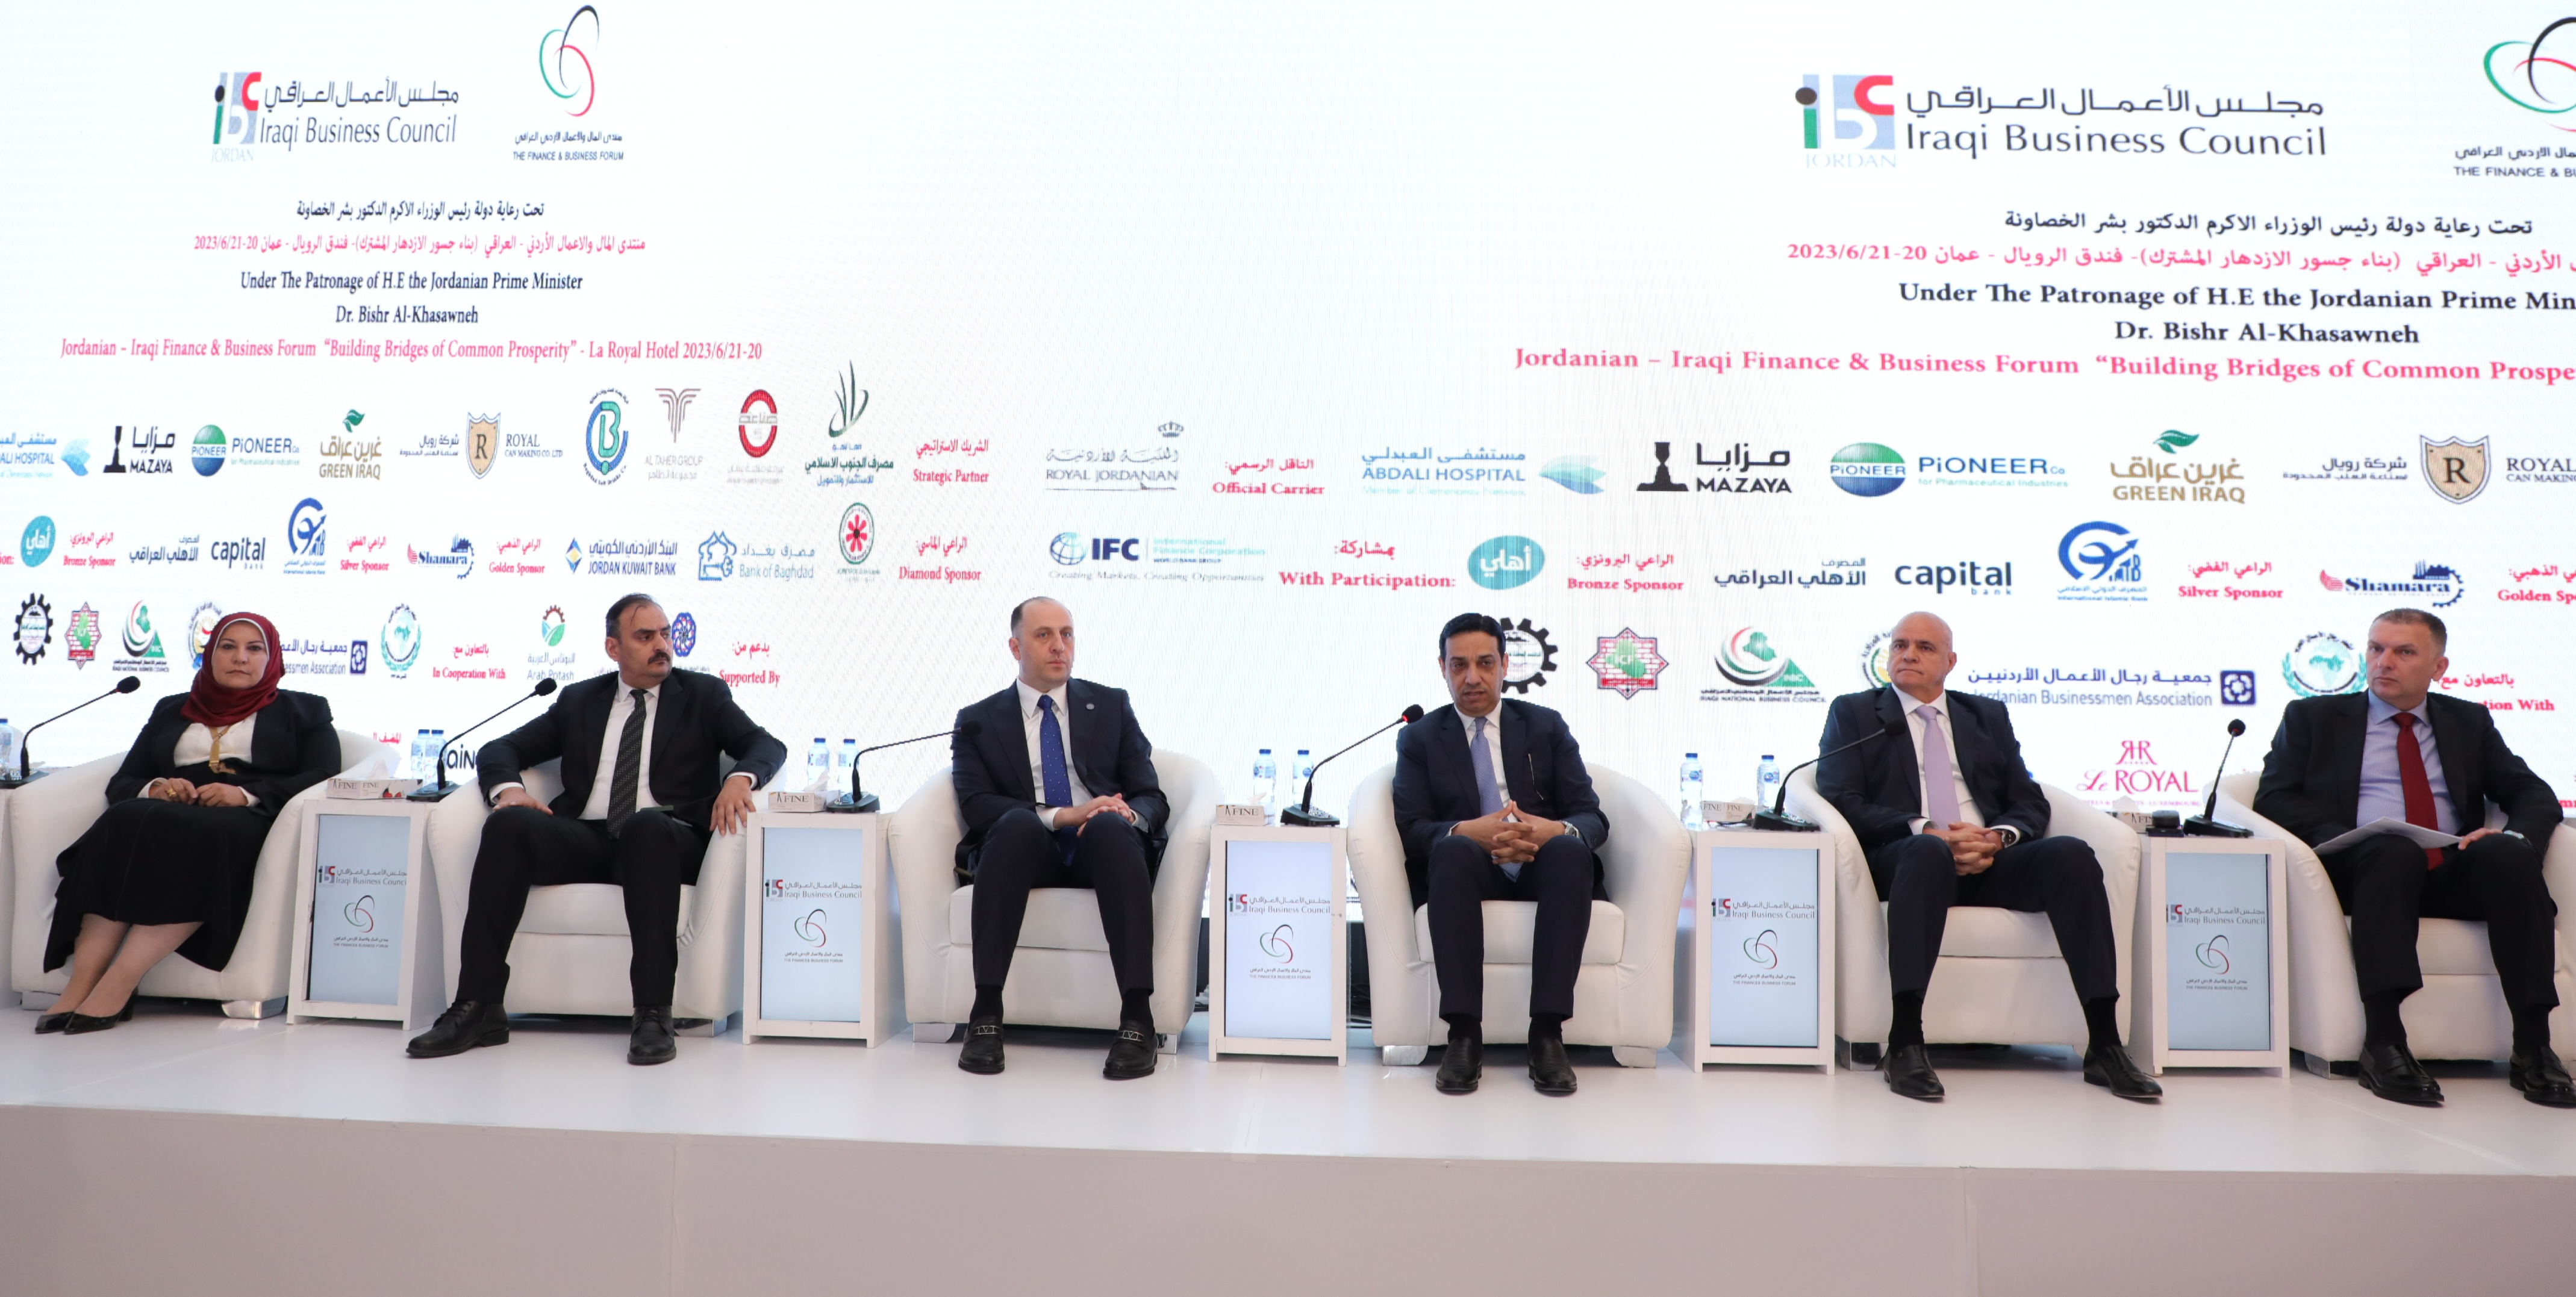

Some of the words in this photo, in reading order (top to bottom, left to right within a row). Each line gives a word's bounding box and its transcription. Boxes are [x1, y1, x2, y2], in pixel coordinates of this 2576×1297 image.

[1907, 86, 2055, 118] العراقي
[2062, 85, 2189, 116] الأعمال
[2196, 92, 2324, 118] مجلس
[260, 117, 299, 151] Iraqi
[306, 117, 379, 143] Business
[387, 114, 457, 142] Council
[1907, 123, 1987, 159] Iraqi
[2006, 125, 2165, 153] Business
[2180, 126, 2325, 155] Council
[513, 151, 525, 160] THE
[528, 151, 555, 160] FINANCE
[558, 152, 562, 160] &
[565, 151, 597, 160] BUSINESS
[600, 151, 623, 160] FORUM
[2454, 167, 2480, 176] THE
[2486, 167, 2544, 176] FINANCE
[2551, 168, 2559, 177] &
[2006, 211, 2085, 231] الخصاونة
[2094, 214, 2126, 233] بشر
[2136, 213, 2198, 234] الدكتور
[2207, 214, 2256, 237] الاكرم
[2265, 216, 2321, 236] الوزراء
[2331, 217, 2377, 237] رئيس
[2386, 216, 2425, 237] دولة
[2434, 217, 2480, 238] رعاية
[2489, 220, 2532, 234] تحت
[1789, 244, 1927, 260] 2023/6/21-20
[242, 271, 276, 288] Under
[281, 271, 301, 288] The
[305, 272, 363, 294] Patronage
[367, 271, 380, 288] of
[382, 272, 405, 288] H.E
[409, 271, 427, 288] the
[431, 272, 488, 291] Jordanian
[493, 272, 528, 289] Prime
[532, 272, 583, 289] Minister
[1899, 283, 1977, 301] Under
[1986, 284, 2031, 302] The
[2041, 285, 2164, 309] Patronage
[2174, 287, 2200, 304] of
[2207, 288, 2254, 305] H.E
[2263, 288, 2301, 306] the
[2310, 290, 2432, 309] Jordanian
[2442, 291, 2516, 309] Prime
[336, 305, 353, 322] Dr.
[358, 305, 389, 323] Bishr
[393, 305, 478, 323] Al-Khasawneh
[2116, 322, 2153, 338] Dr.
[2164, 322, 2228, 340] Bishr
[2239, 323, 2419, 343] Al-Khasawneh
[61, 338, 116, 357] Jordanian
[131, 339, 158, 361] Iraqi
[163, 339, 207, 355] Finance
[211, 339, 220, 356] &
[225, 340, 273, 356] Business
[278, 339, 316, 356] Forum
[385, 339, 428, 362] Bridges
[432, 340, 445, 356] of
[448, 340, 503, 357] Common
[590, 341, 603, 358] La
[608, 341, 641, 363] Royal
[646, 341, 679, 358] Hotel
[683, 343, 762, 359] 2023/6/21-20
[1516, 348, 1638, 369] Jordanian
[1673, 350, 1731, 374] Iraqi
[1744, 352, 1839, 370] Finance
[1850, 353, 1868, 370] &
[1880, 353, 1985, 372] Business
[1996, 355, 2079, 373] Forum
[2228, 358, 2320, 382] Bridges
[2329, 359, 2355, 377] of
[2363, 360, 2480, 379] Common
[2490, 362, 2575, 385] Prospe
[232, 438, 292, 453] PiONEER
[506, 434, 540, 447] ROYAL
[130, 459, 172, 473] MAZAYA
[1696, 443, 1790, 473] مزايا
[1919, 457, 2047, 474] PiONEER
[2507, 458, 2576, 471] ROYAL
[319, 464, 353, 478] GREEN
[356, 464, 380, 480] IRAQ
[914, 468, 952, 486] Strategic
[956, 470, 988, 482] Partner
[1047, 470, 1090, 480] ROYAL
[1096, 470, 1178, 482] JORDANIAN
[1362, 467, 1429, 480] ABDALI
[1436, 468, 1525, 481] HOSPITAL
[1830, 464, 1906, 476] PiONEER
[2444, 458, 2471, 483] R
[1212, 482, 1266, 494] Official
[1271, 483, 1324, 494] Carrier
[1696, 477, 1792, 493] MAZAYA
[2113, 486, 2185, 501] GREEN
[2190, 483, 2244, 504] IRAQ
[211, 538, 266, 568] capital
[1092, 538, 1139, 561] IFC
[63, 555, 86, 565] Bronze
[89, 556, 116, 568] Sponsor
[341, 559, 359, 570] Silver
[361, 560, 389, 573] Sponsor
[489, 562, 514, 573] Golden
[517, 562, 544, 576] Sponsor
[588, 561, 620, 574] JORDAN
[622, 562, 652, 574] KUWAIT
[655, 562, 676, 575] BANK
[740, 564, 761, 578] Bank
[763, 564, 772, 578] of
[775, 564, 813, 582] Baghdad
[899, 566, 941, 580] Diamond
[944, 567, 981, 583] Sponsor
[1279, 571, 1324, 585] With
[1332, 573, 1455, 590] Participation:
[1895, 561, 2011, 594] capital
[1568, 578, 1618, 589] Bronze
[1624, 579, 1684, 593] Sponsor
[2178, 586, 2219, 597] Silver
[2225, 586, 2283, 600] Sponsor
[2345, 579, 2450, 592] Shamara
[2498, 589, 2551, 602] Golden
[433, 667, 440, 677] In
[443, 667, 486, 681] Cooperation
[488, 668, 505, 679] With
[528, 670, 546, 680] Arab
[548, 670, 574, 680] Potash
[720, 670, 766, 687] Supported
[769, 670, 780, 688] By
[1968, 667, 2039, 683] الأردنيين
[2043, 668, 2106, 684] الأعمال
[2111, 669, 2147, 685] رجال
[2153, 671, 2212, 685] جمعية
[2041, 689, 2132, 705] Businessmen
[2136, 691, 2212, 706] Association
[2518, 700, 2554, 711] With
[2116, 770, 2197, 794] ROYAL
[1233, 807, 1259, 816] FINE
[1250, 906, 1265, 914] Iraqi
[2185, 916, 2200, 925] Iraqi
